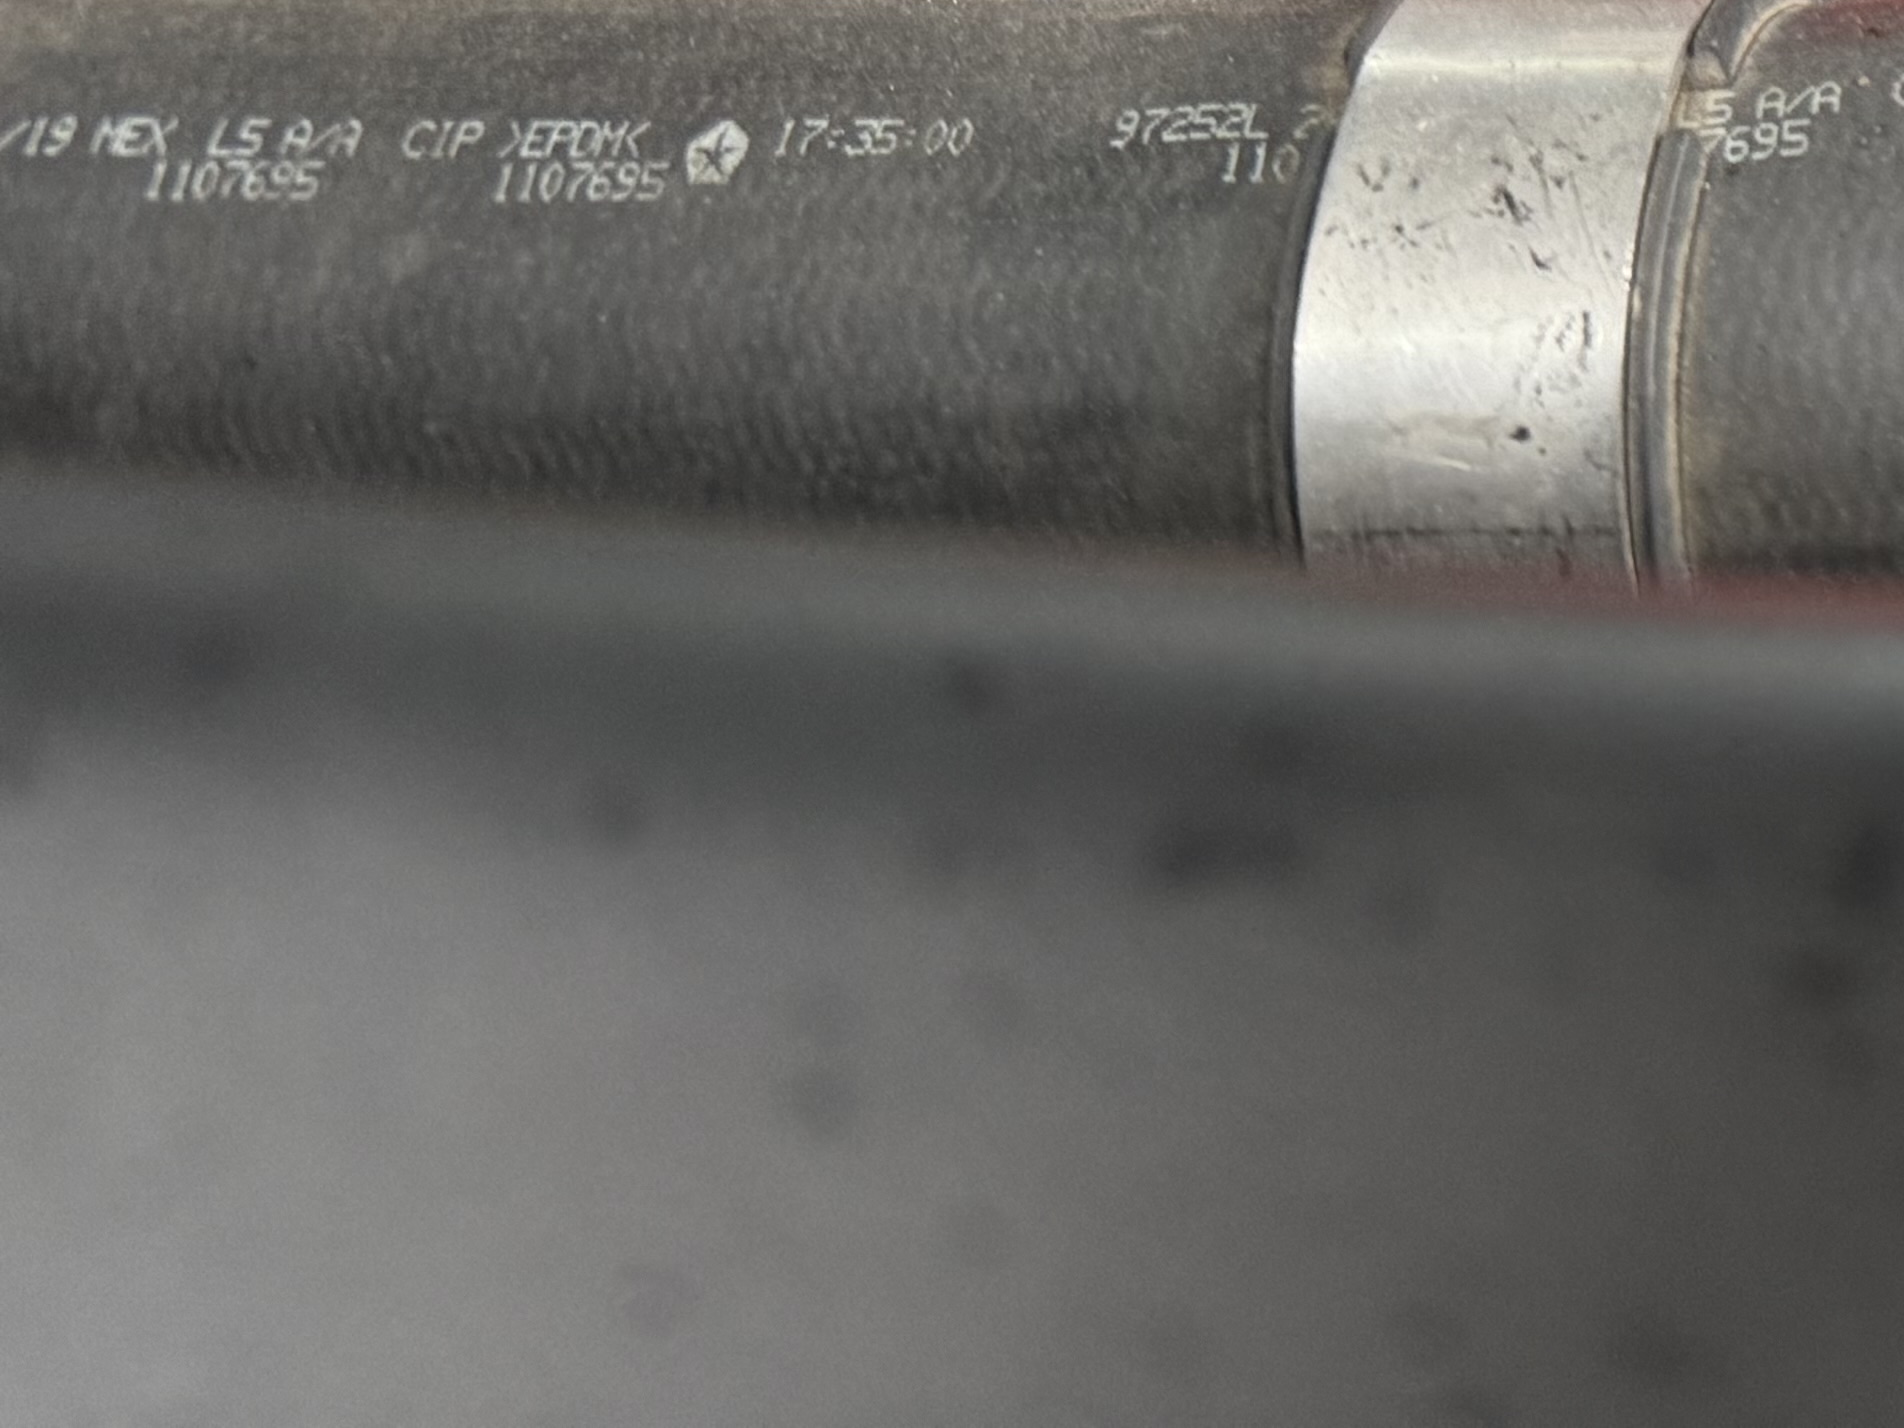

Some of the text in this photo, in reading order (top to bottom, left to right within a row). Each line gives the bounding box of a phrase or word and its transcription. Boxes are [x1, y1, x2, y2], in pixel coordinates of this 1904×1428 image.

[1755, 80, 1843, 120] A/A
[89, 114, 180, 158] MEX
[277, 116, 364, 159] A/A
[401, 119, 486, 160] CIP
[146, 158, 327, 203] 1107695
[494, 159, 671, 204] 1107695
